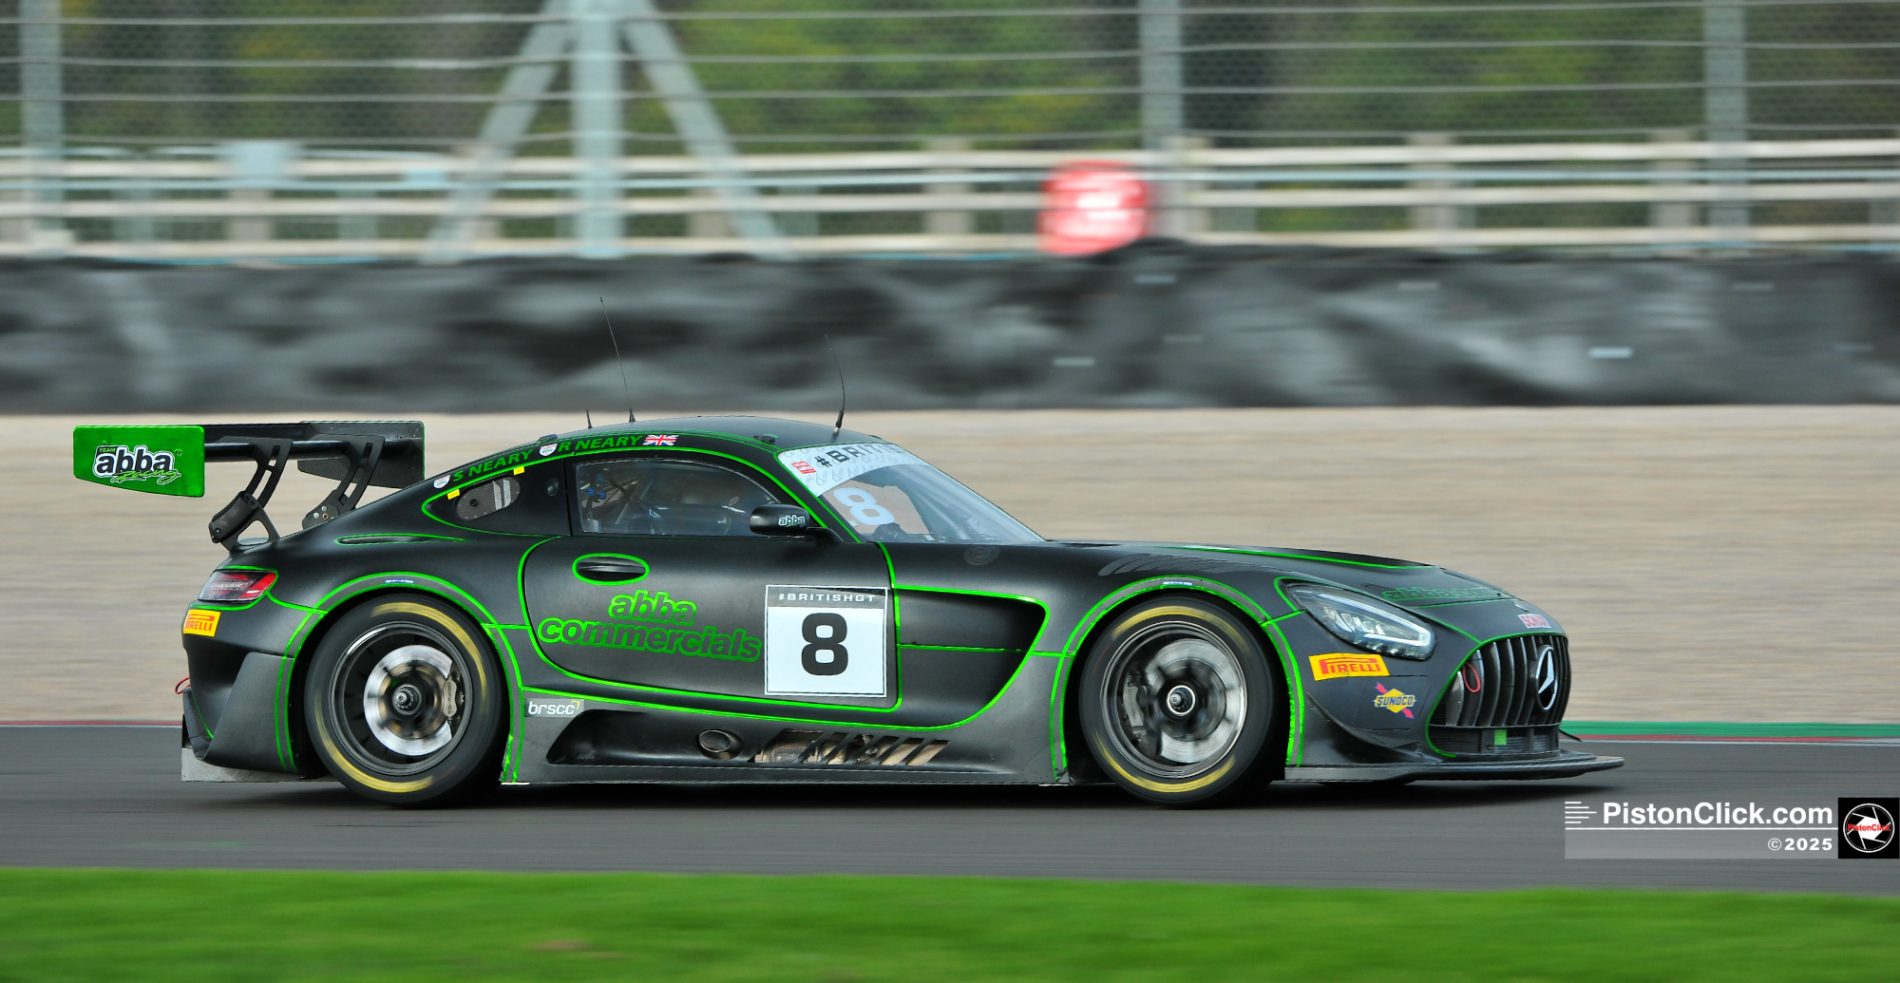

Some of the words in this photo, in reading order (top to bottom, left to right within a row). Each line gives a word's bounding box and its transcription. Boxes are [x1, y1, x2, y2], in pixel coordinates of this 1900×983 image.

[557, 441, 571, 452] R
[575, 435, 642, 450] NEARY
[96, 448, 171, 474] abba
[453, 470, 464, 482] S
[468, 448, 533, 477] NEARY
[833, 486, 896, 526] 8
[778, 514, 806, 526] abba
[608, 590, 698, 627] abba
[779, 592, 876, 603] #BRITISHGT
[537, 616, 762, 663] commercials
[801, 612, 849, 676] 8
[1319, 656, 1382, 676] PIRELLI
[527, 699, 577, 716] brscc
[1373, 694, 1416, 708] SUNOCO
